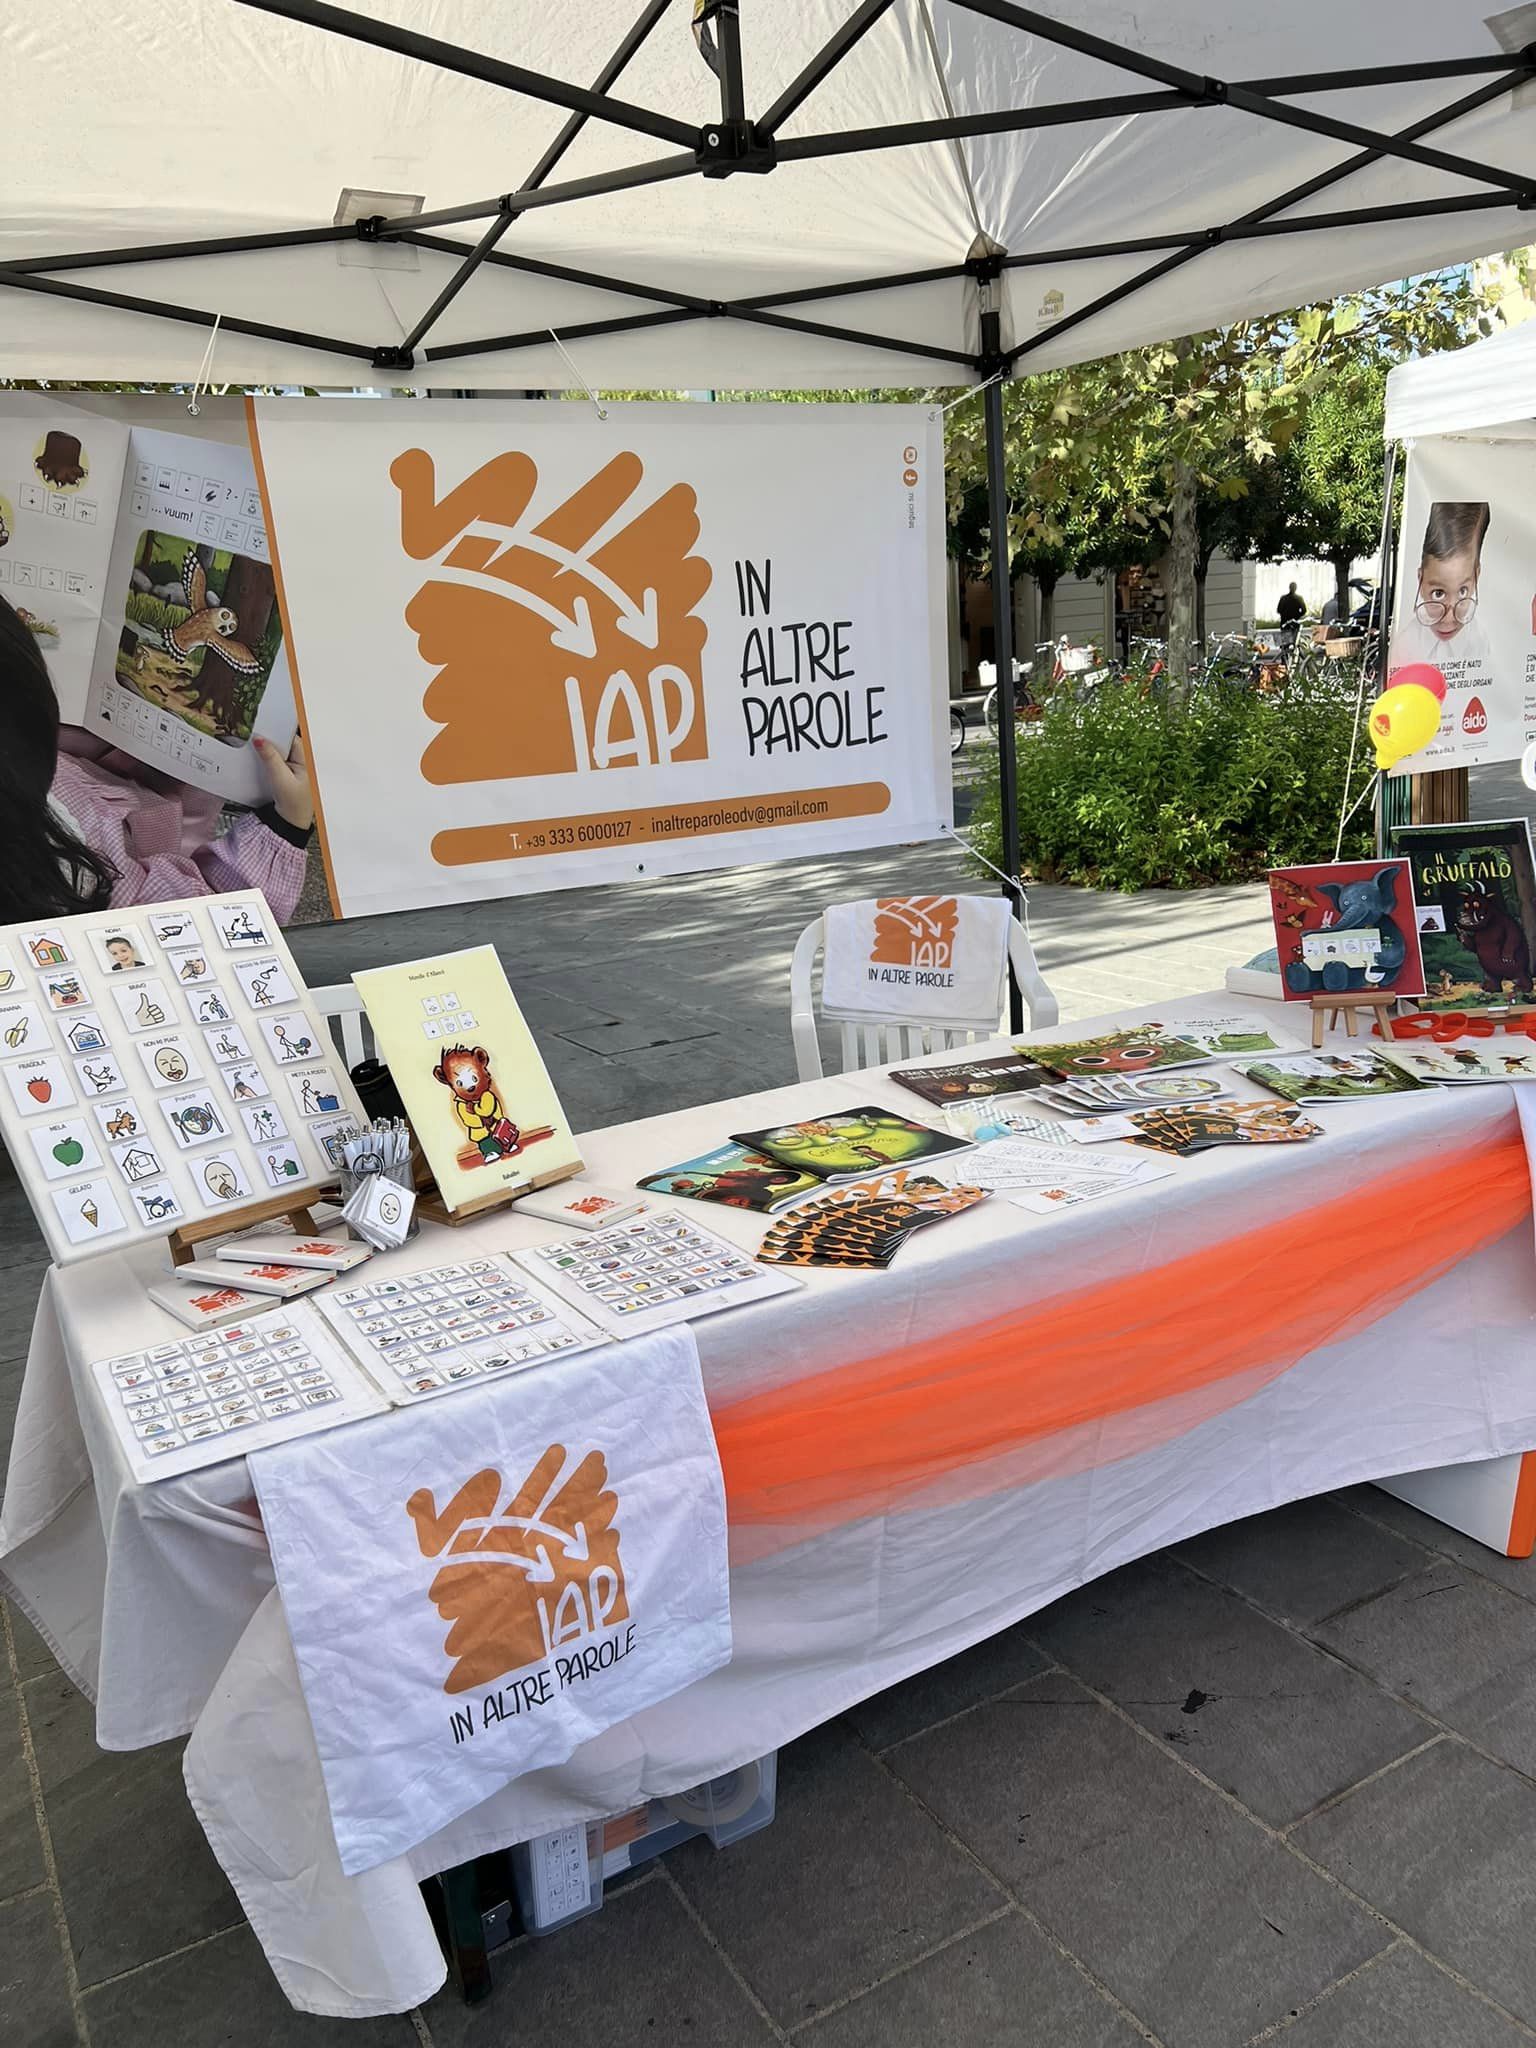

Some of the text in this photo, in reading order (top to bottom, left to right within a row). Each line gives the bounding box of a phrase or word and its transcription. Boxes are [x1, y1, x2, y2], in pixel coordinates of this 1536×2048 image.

[164, 507, 194, 523] vuum!
[735, 557, 771, 617] IN
[740, 621, 855, 688] ALTRE
[565, 664, 695, 773] IAP
[742, 687, 888, 756] PAROLE
[1463, 711, 1487, 729] aido
[509, 833, 522, 850] T.
[526, 835, 545, 848] +39
[548, 827, 574, 845] 333
[578, 821, 632, 842] 6000127
[651, 800, 829, 832] inaltreparoleodv@gmail.com
[911, 941, 948, 967] IAP
[868, 967, 954, 988] IN ALTRE PAROLE
[18, 1060, 46, 1069] FRAGOLA
[49, 1123, 67, 1131] MELA
[69, 1184, 92, 1194] GELATO
[536, 1564, 618, 1656] IAP
[449, 1623, 637, 1744] IN ALTRE PAROLE
